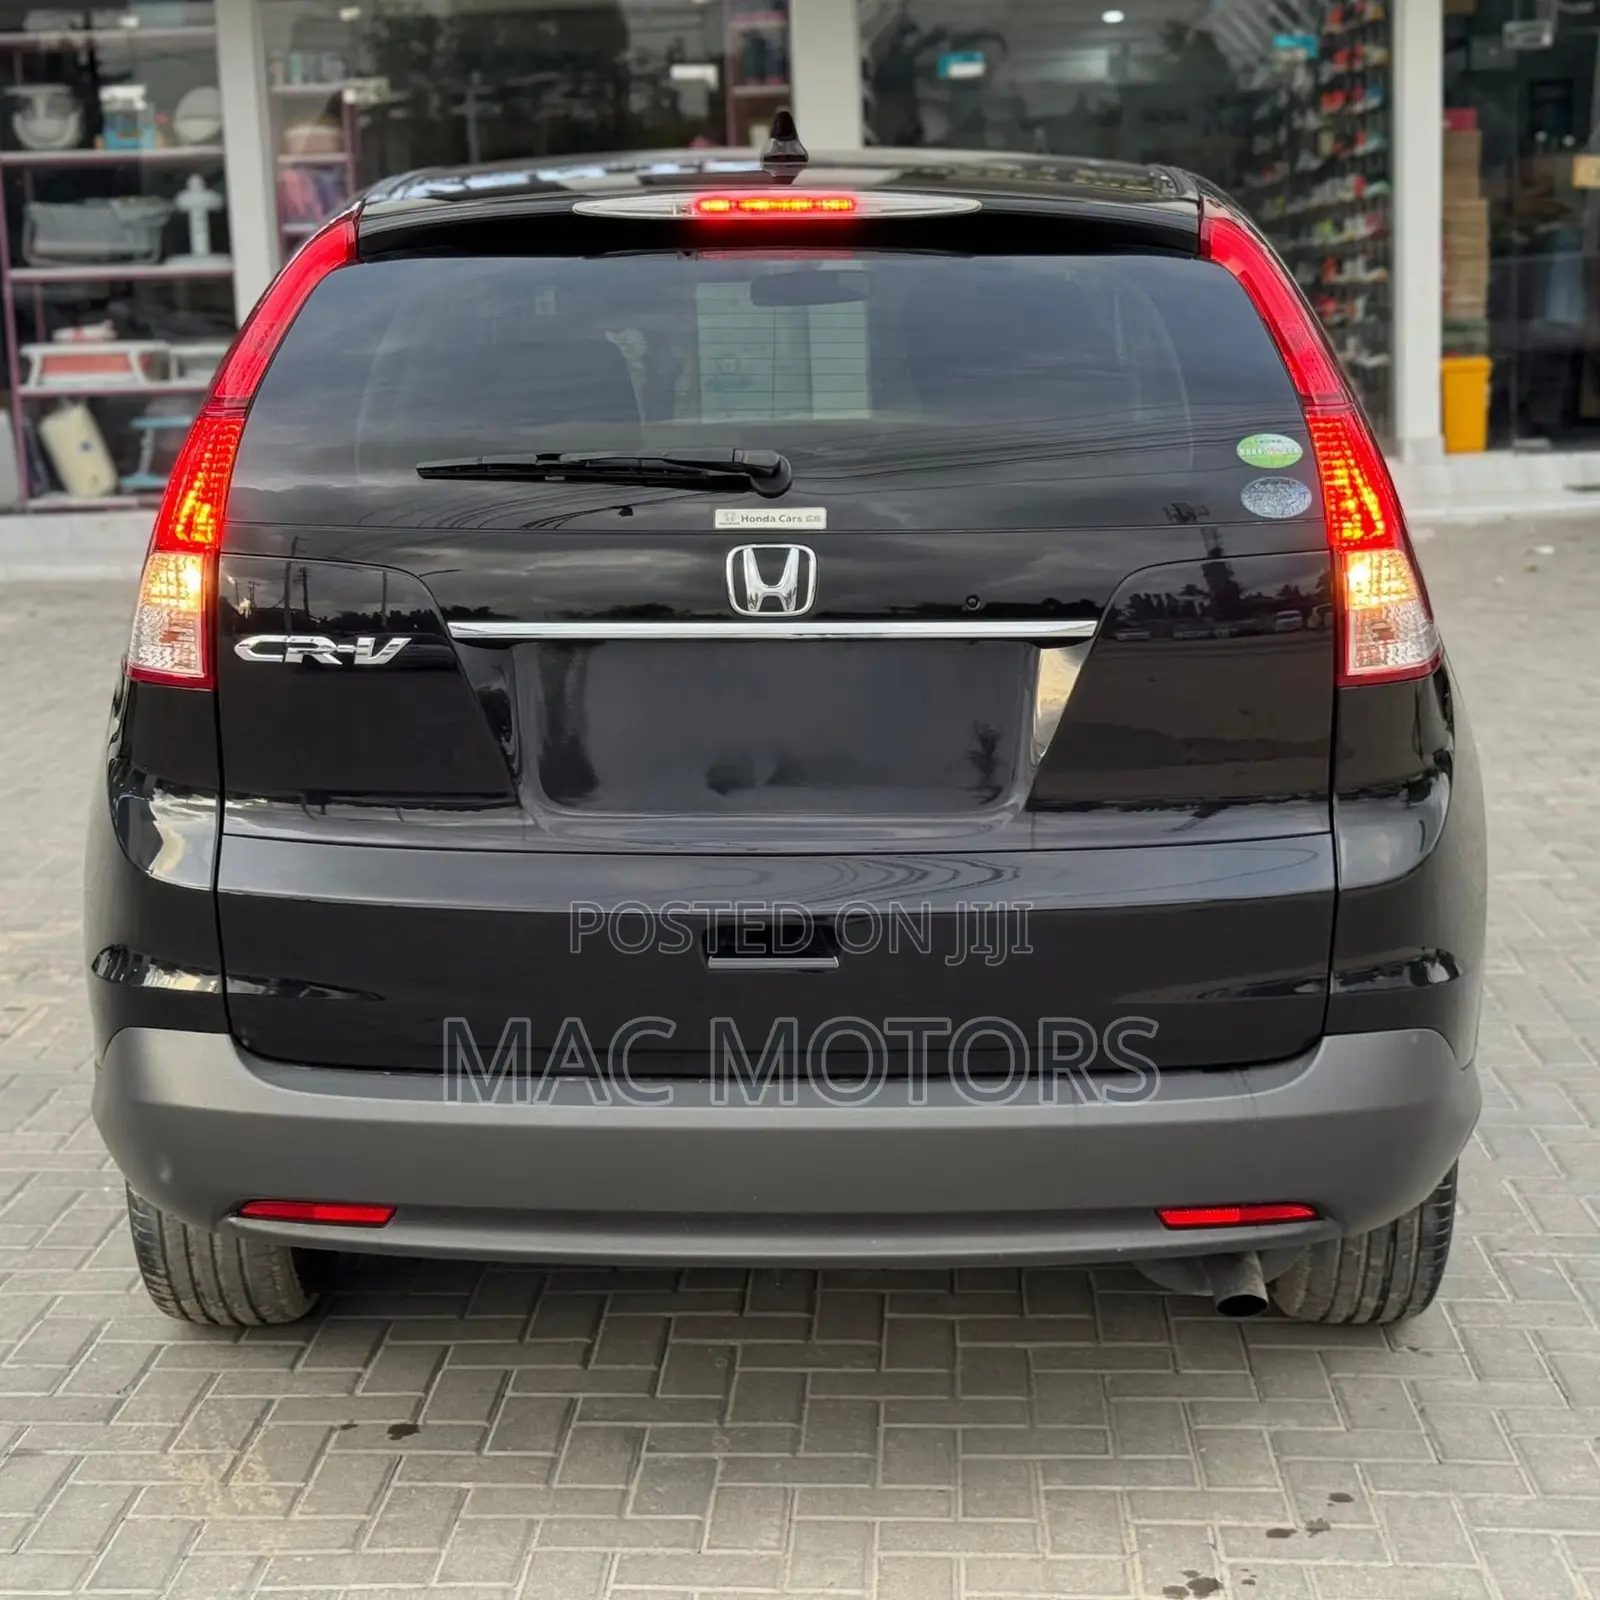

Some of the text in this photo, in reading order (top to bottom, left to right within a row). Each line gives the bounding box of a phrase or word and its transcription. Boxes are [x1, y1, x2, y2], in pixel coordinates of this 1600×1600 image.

[741, 514, 776, 523] Honda
[779, 514, 803, 523] Cars
[234, 634, 413, 665] CR-V
